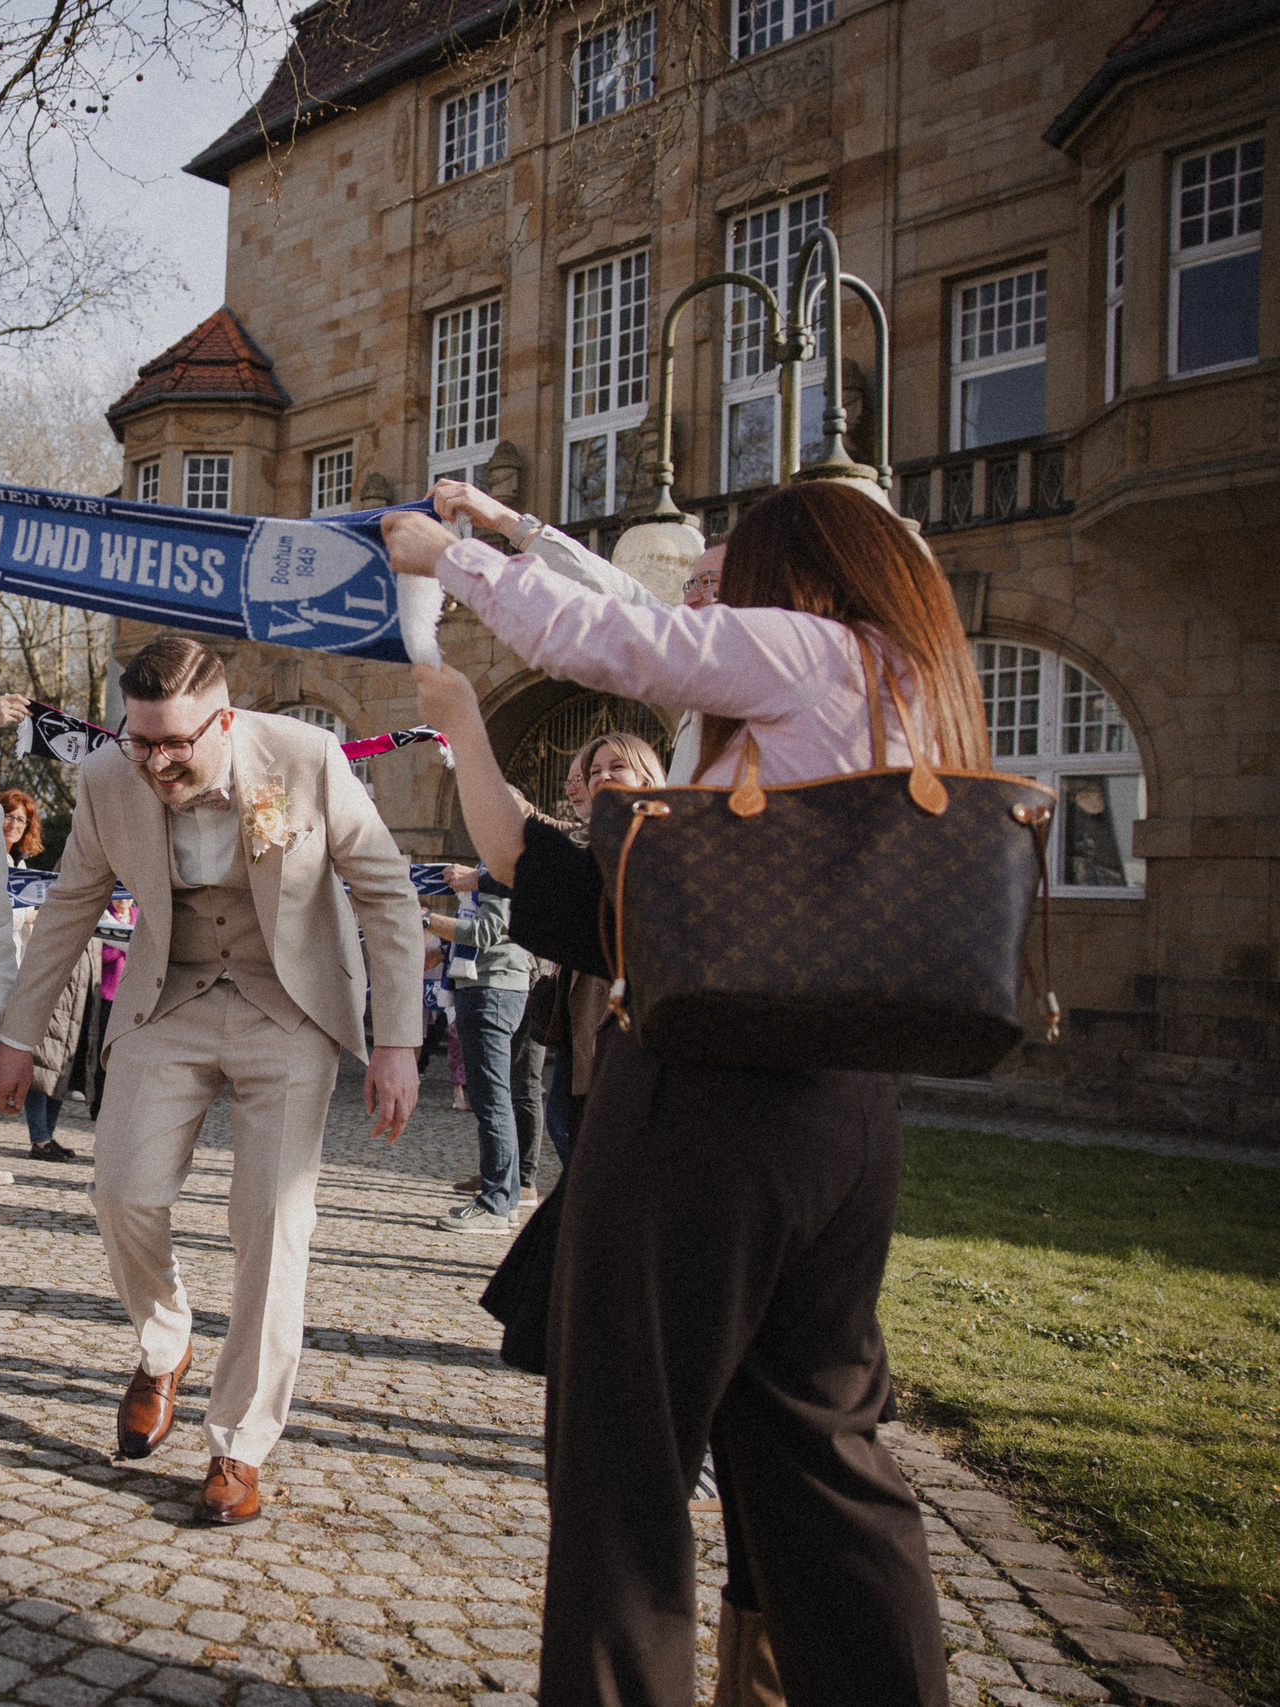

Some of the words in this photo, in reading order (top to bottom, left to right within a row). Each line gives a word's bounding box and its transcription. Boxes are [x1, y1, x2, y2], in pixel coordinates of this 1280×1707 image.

[46, 495, 107, 516] WIR!
[12, 518, 91, 573] UND
[99, 531, 226, 598] WEISS
[270, 535, 294, 585] Bochum
[295, 546, 318, 578] 1848
[267, 575, 389, 639] VfL
